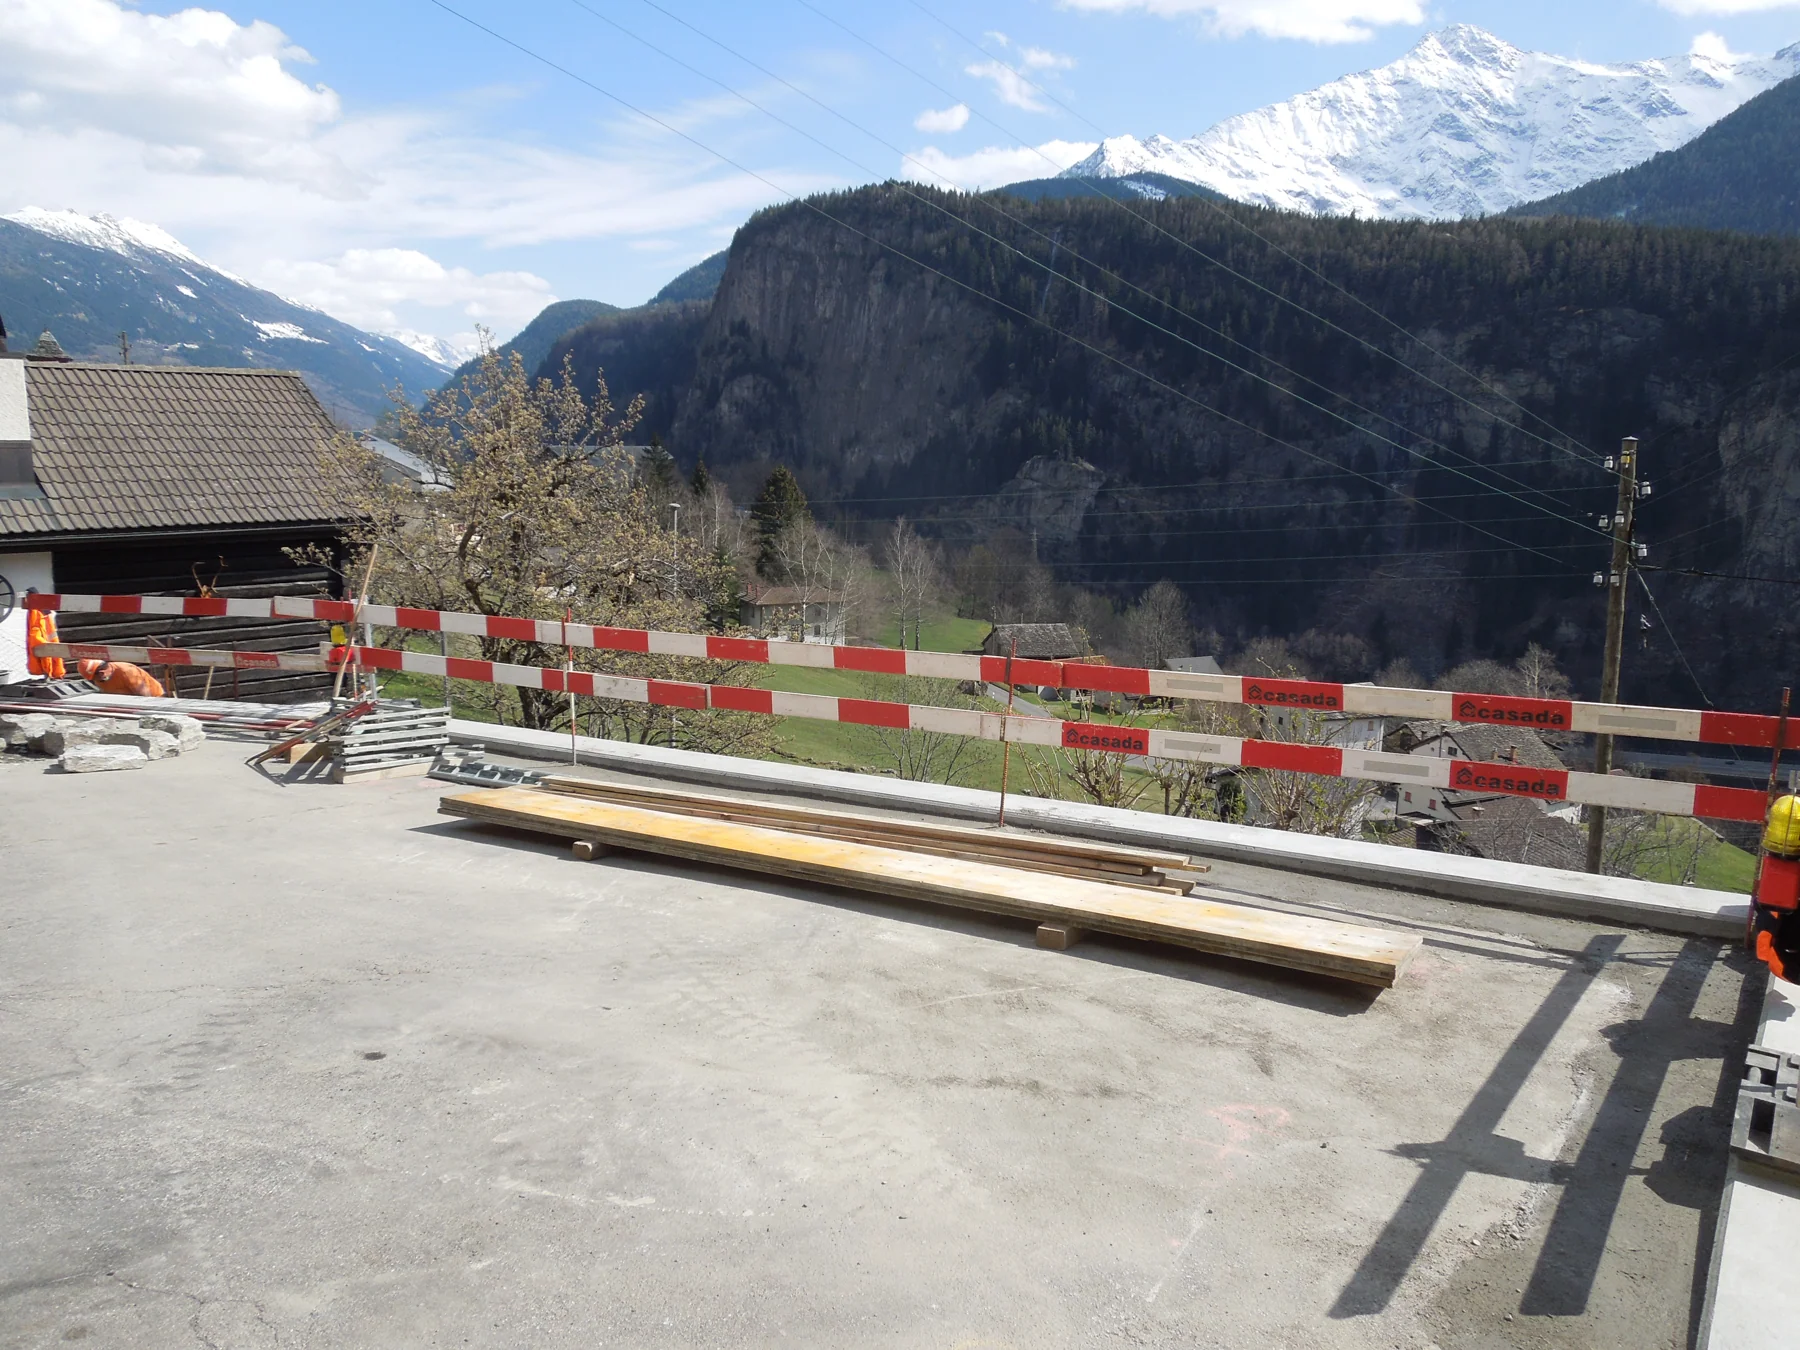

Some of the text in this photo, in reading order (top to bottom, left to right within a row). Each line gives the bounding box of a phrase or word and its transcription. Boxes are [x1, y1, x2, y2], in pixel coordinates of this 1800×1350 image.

[1263, 691, 1338, 707] casada
[1478, 708, 1565, 725] casada
[1079, 735, 1144, 750] casada
[1474, 775, 1560, 796] casada
